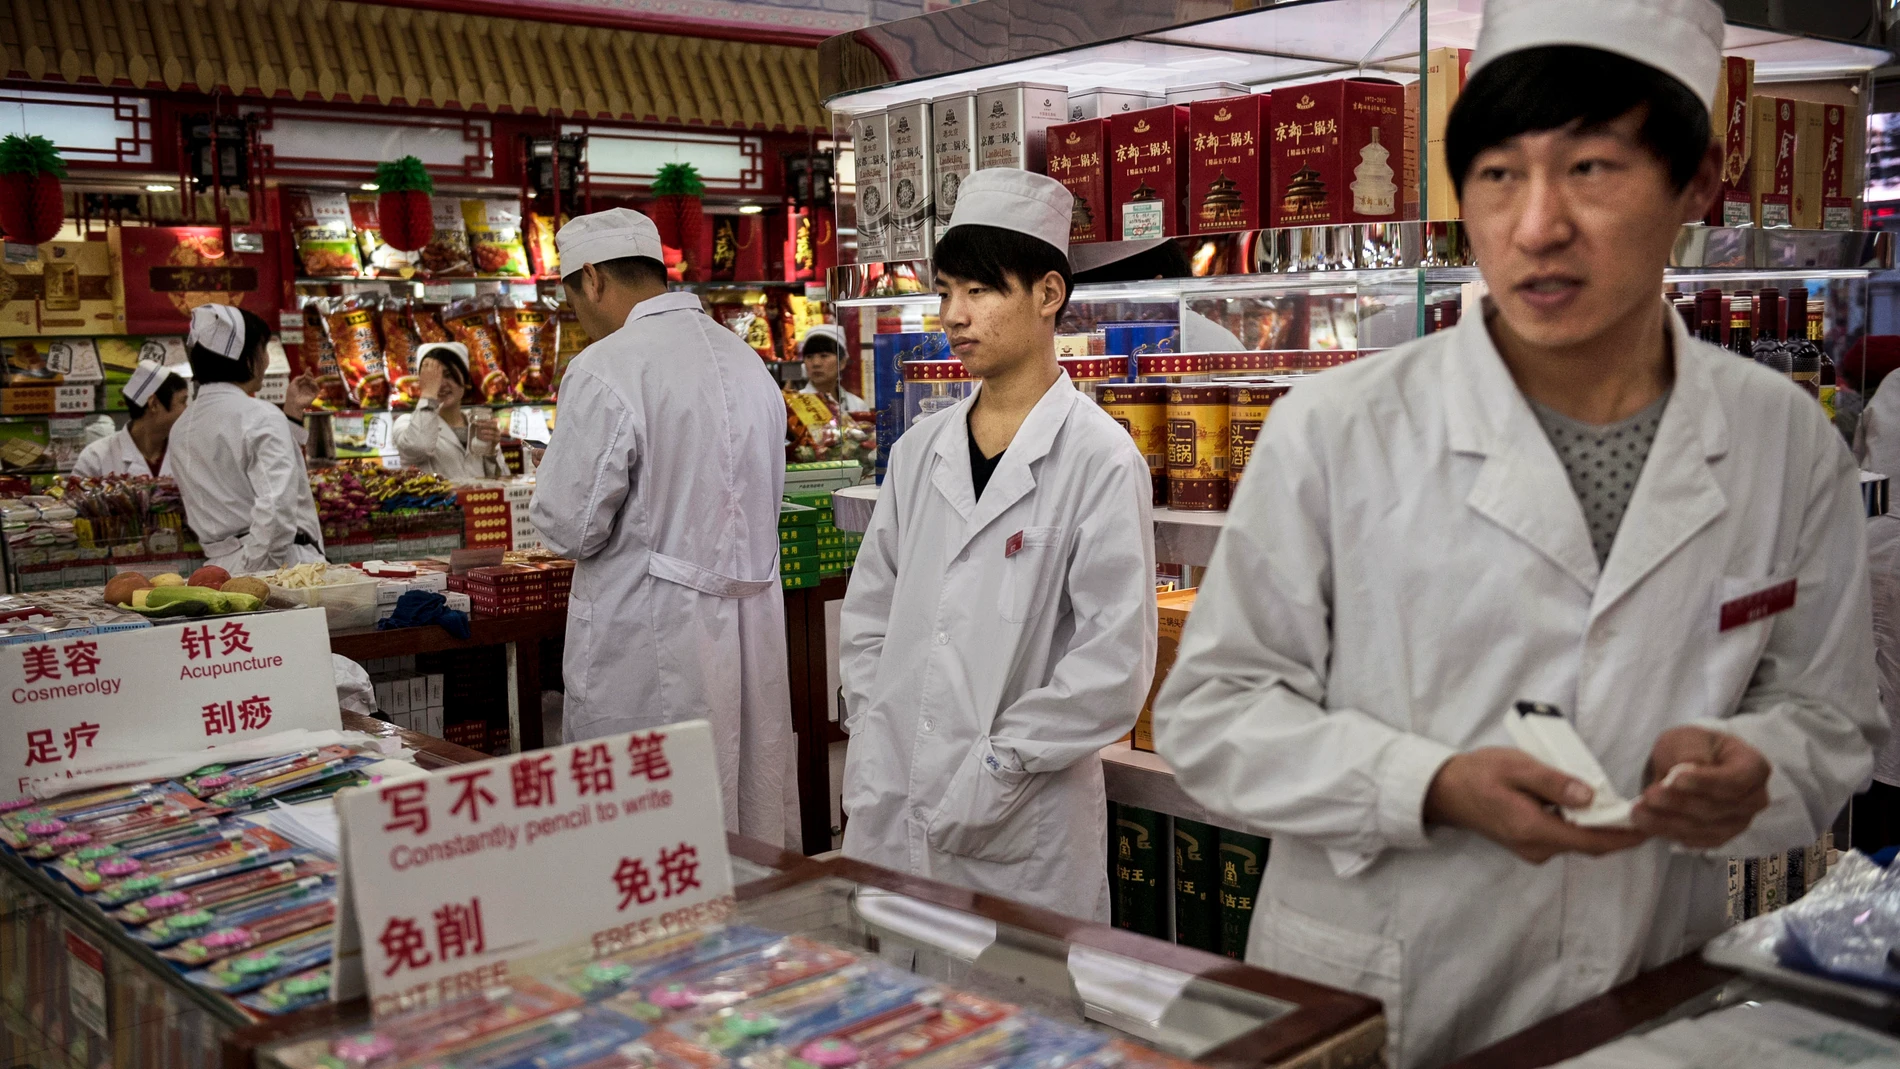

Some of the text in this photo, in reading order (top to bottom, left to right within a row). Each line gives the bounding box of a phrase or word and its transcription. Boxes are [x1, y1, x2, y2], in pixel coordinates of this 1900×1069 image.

[936, 139, 969, 154] 京都二锅头
[981, 132, 1018, 147] 京都二锅头
[1193, 131, 1254, 155] 京都二锅头
[1274, 118, 1338, 145] 京都二锅头
[1050, 152, 1100, 175] 京都二锅头
[1115, 140, 1171, 165] 京都二锅头
[180, 620, 254, 661] 针灸
[22, 640, 102, 684] 美容
[180, 654, 283, 680] Acupuncture
[12, 677, 122, 705] Cosmerolgy
[201, 695, 273, 737] 刮痧
[24, 721, 101, 768] 足疗
[378, 731, 674, 837] 写不断铅笔
[389, 787, 675, 871] Constantly pencil to write
[611, 841, 703, 912] 免按
[376, 896, 487, 978] 免削
